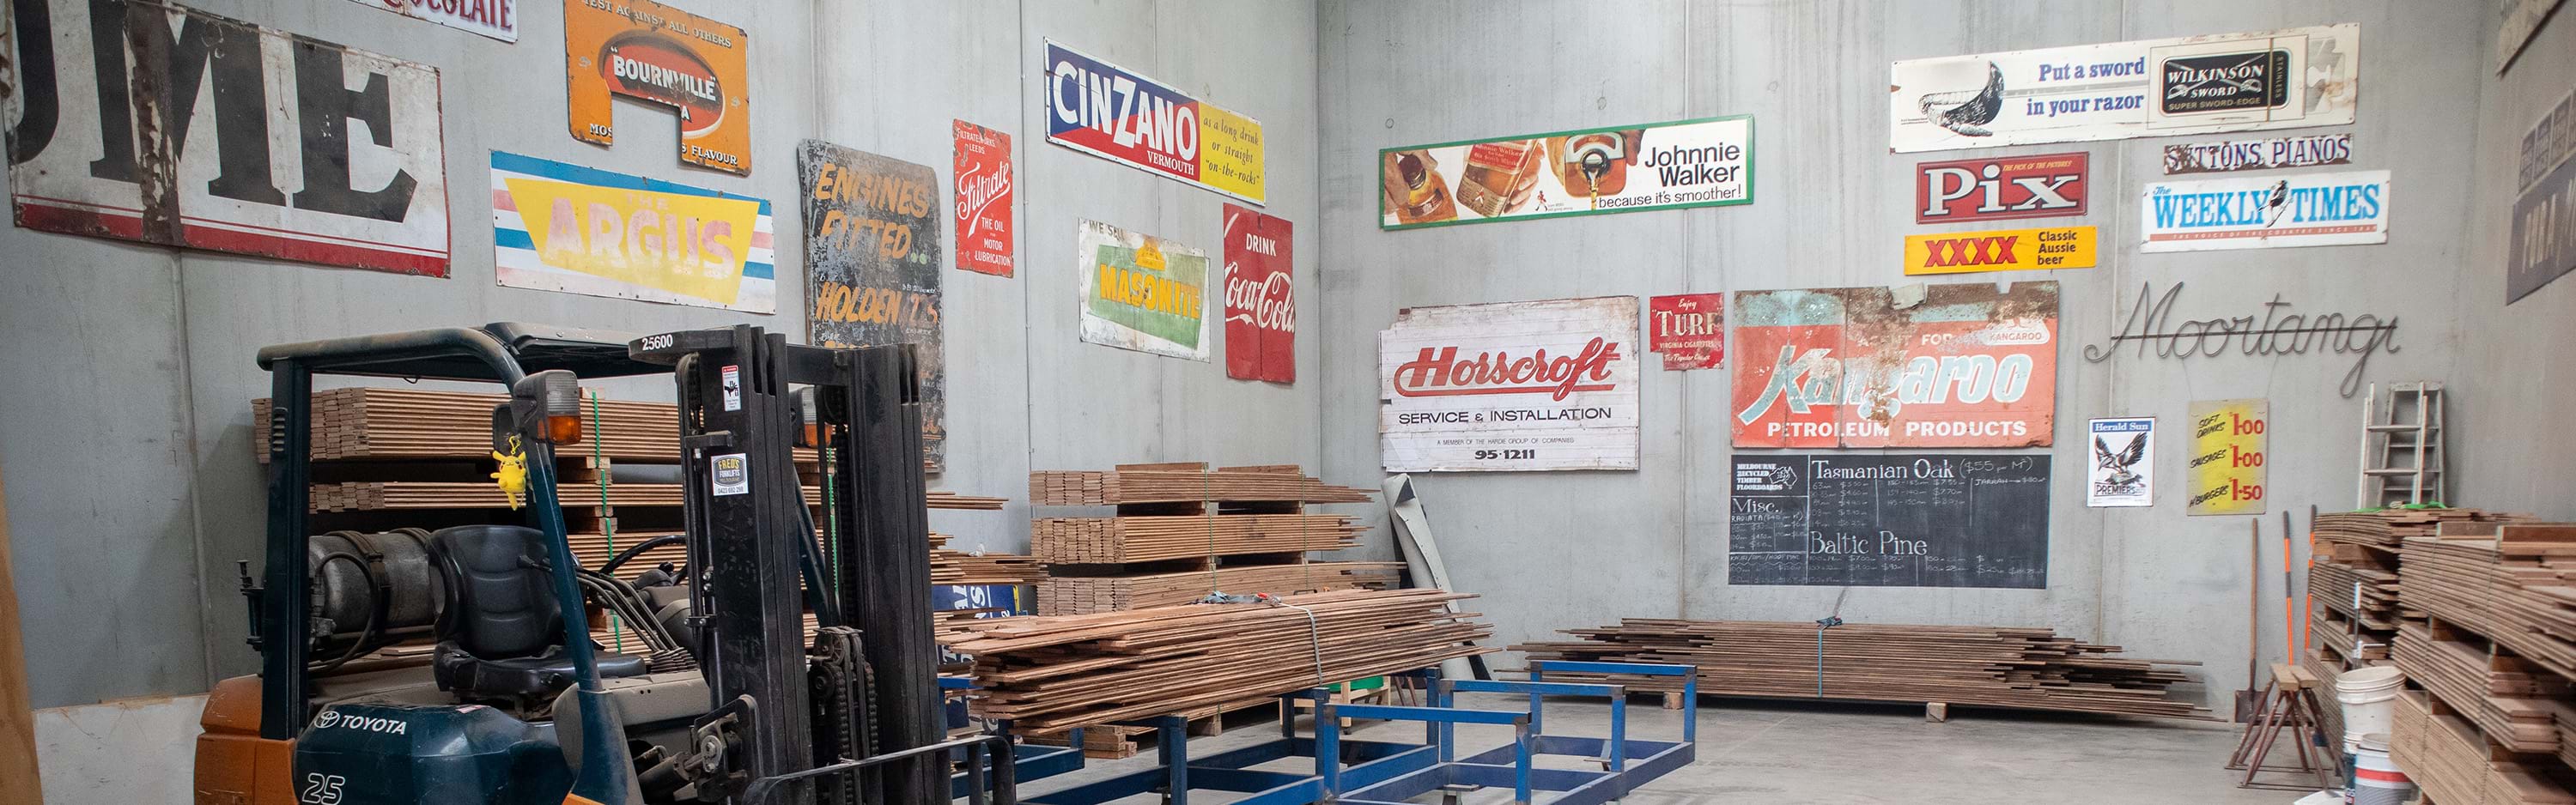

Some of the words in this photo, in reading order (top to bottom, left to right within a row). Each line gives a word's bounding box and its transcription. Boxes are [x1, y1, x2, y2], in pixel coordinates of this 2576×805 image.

[669, 21, 689, 35] ALL
[693, 27, 732, 48] OTHERS
[2038, 63, 2070, 82] Put
[2075, 66, 2085, 80] a
[2089, 57, 2145, 79] sword
[2168, 64, 2264, 83] WILKINSON
[2190, 86, 2237, 98] SWORD
[1053, 60, 1197, 161] CINZANO
[2026, 97, 2044, 116] in
[2048, 100, 2090, 118] your
[2093, 95, 2144, 112] razor
[2199, 97, 2261, 109] SWORD-EDGE
[1203, 117, 1211, 128] as
[1213, 122, 1218, 130] a
[1221, 118, 1237, 142] long
[1240, 127, 1259, 146] drink
[691, 145, 738, 166] FLAVOUR
[1212, 142, 1221, 152] or
[1224, 146, 1253, 166] straight
[1644, 142, 1741, 168] Johnnie
[2168, 142, 2261, 168] STTONS
[2271, 136, 2351, 165] PIANOS
[1146, 150, 1194, 176] VERMOUTH
[1659, 163, 1741, 187] Walker
[816, 162, 929, 218] ENGINES
[957, 161, 1011, 227] Filtrate
[1599, 195, 1652, 209] because
[1656, 190, 1671, 203] it's
[1674, 184, 1741, 203] smoother!
[1923, 164, 2080, 216] Pix
[2153, 185, 2172, 196] The
[625, 192, 670, 210] THE
[2153, 189, 2271, 229] WEEKLY
[2290, 183, 2380, 223] TIMES
[981, 216, 993, 229] THE
[993, 219, 1005, 233] OIL
[1089, 219, 1104, 234] WE
[543, 197, 737, 280] ARGUS
[983, 238, 1003, 251] MOTOR
[1246, 233, 1277, 257] DRINK
[2038, 230, 2077, 242] Classic
[1924, 235, 2019, 268] XXXX
[2038, 242, 2076, 254] Aussie
[2037, 254, 2064, 265] beer
[1100, 263, 1200, 320] MASONITE
[815, 281, 902, 325] HOLDEN
[1678, 298, 1698, 311] Enjoy
[641, 334, 673, 351] 25600
[1989, 331, 2042, 342] KANGAROO
[1394, 336, 1621, 402] Horscroft
[1737, 344, 2033, 426] Kangaroo
[1399, 411, 1468, 425] SERVICE
[1474, 413, 1484, 422] &
[1490, 408, 1612, 422] INSTALLATION
[2095, 422, 2127, 432] Herald
[2129, 422, 2148, 431] Sun
[2198, 414, 2221, 429] SOFT
[1767, 422, 1889, 438] PETROLEUM
[1906, 421, 2027, 437] PRODUCTS
[2196, 421, 2226, 439] DRINKS
[717, 457, 740, 470] FRED'S
[1812, 460, 1907, 479] Tasmanian
[1914, 458, 1954, 479] Oak
[2190, 449, 2227, 469] SAUSAGES
[719, 469, 740, 478] FORKLIFTS
[2096, 484, 2136, 495] PREMIERS
[1732, 498, 1779, 513] Misc.
[1810, 530, 1868, 554] Baltic
[1879, 530, 1928, 555] Pine
[341, 715, 407, 735] TOYOTA
[301, 772, 346, 805] 25
